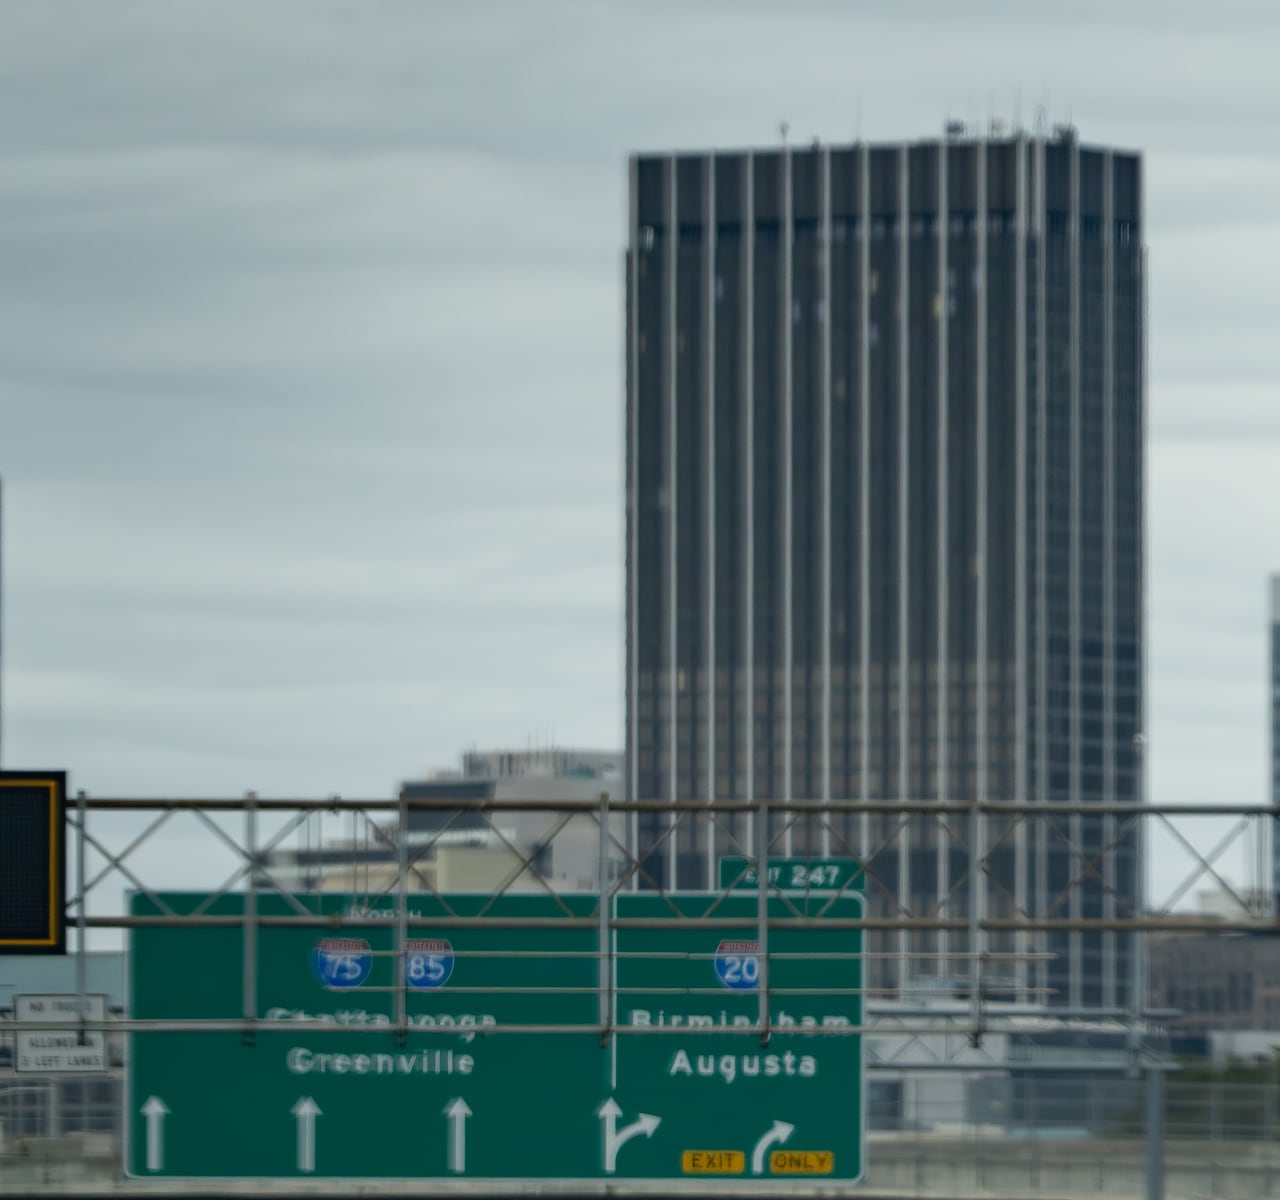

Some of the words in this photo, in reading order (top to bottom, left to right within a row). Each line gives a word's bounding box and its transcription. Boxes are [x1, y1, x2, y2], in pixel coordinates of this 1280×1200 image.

[744, 866, 781, 883] EIT
[790, 864, 839, 887] 247
[327, 953, 362, 980] 75
[409, 953, 445, 980] 85
[723, 956, 760, 984] 20
[631, 1010, 850, 1043] Birminham
[286, 1047, 475, 1074] Greenville
[669, 1050, 817, 1084] Augusta
[691, 1152, 735, 1169] EXIT
[774, 1153, 827, 1169] ONLY
